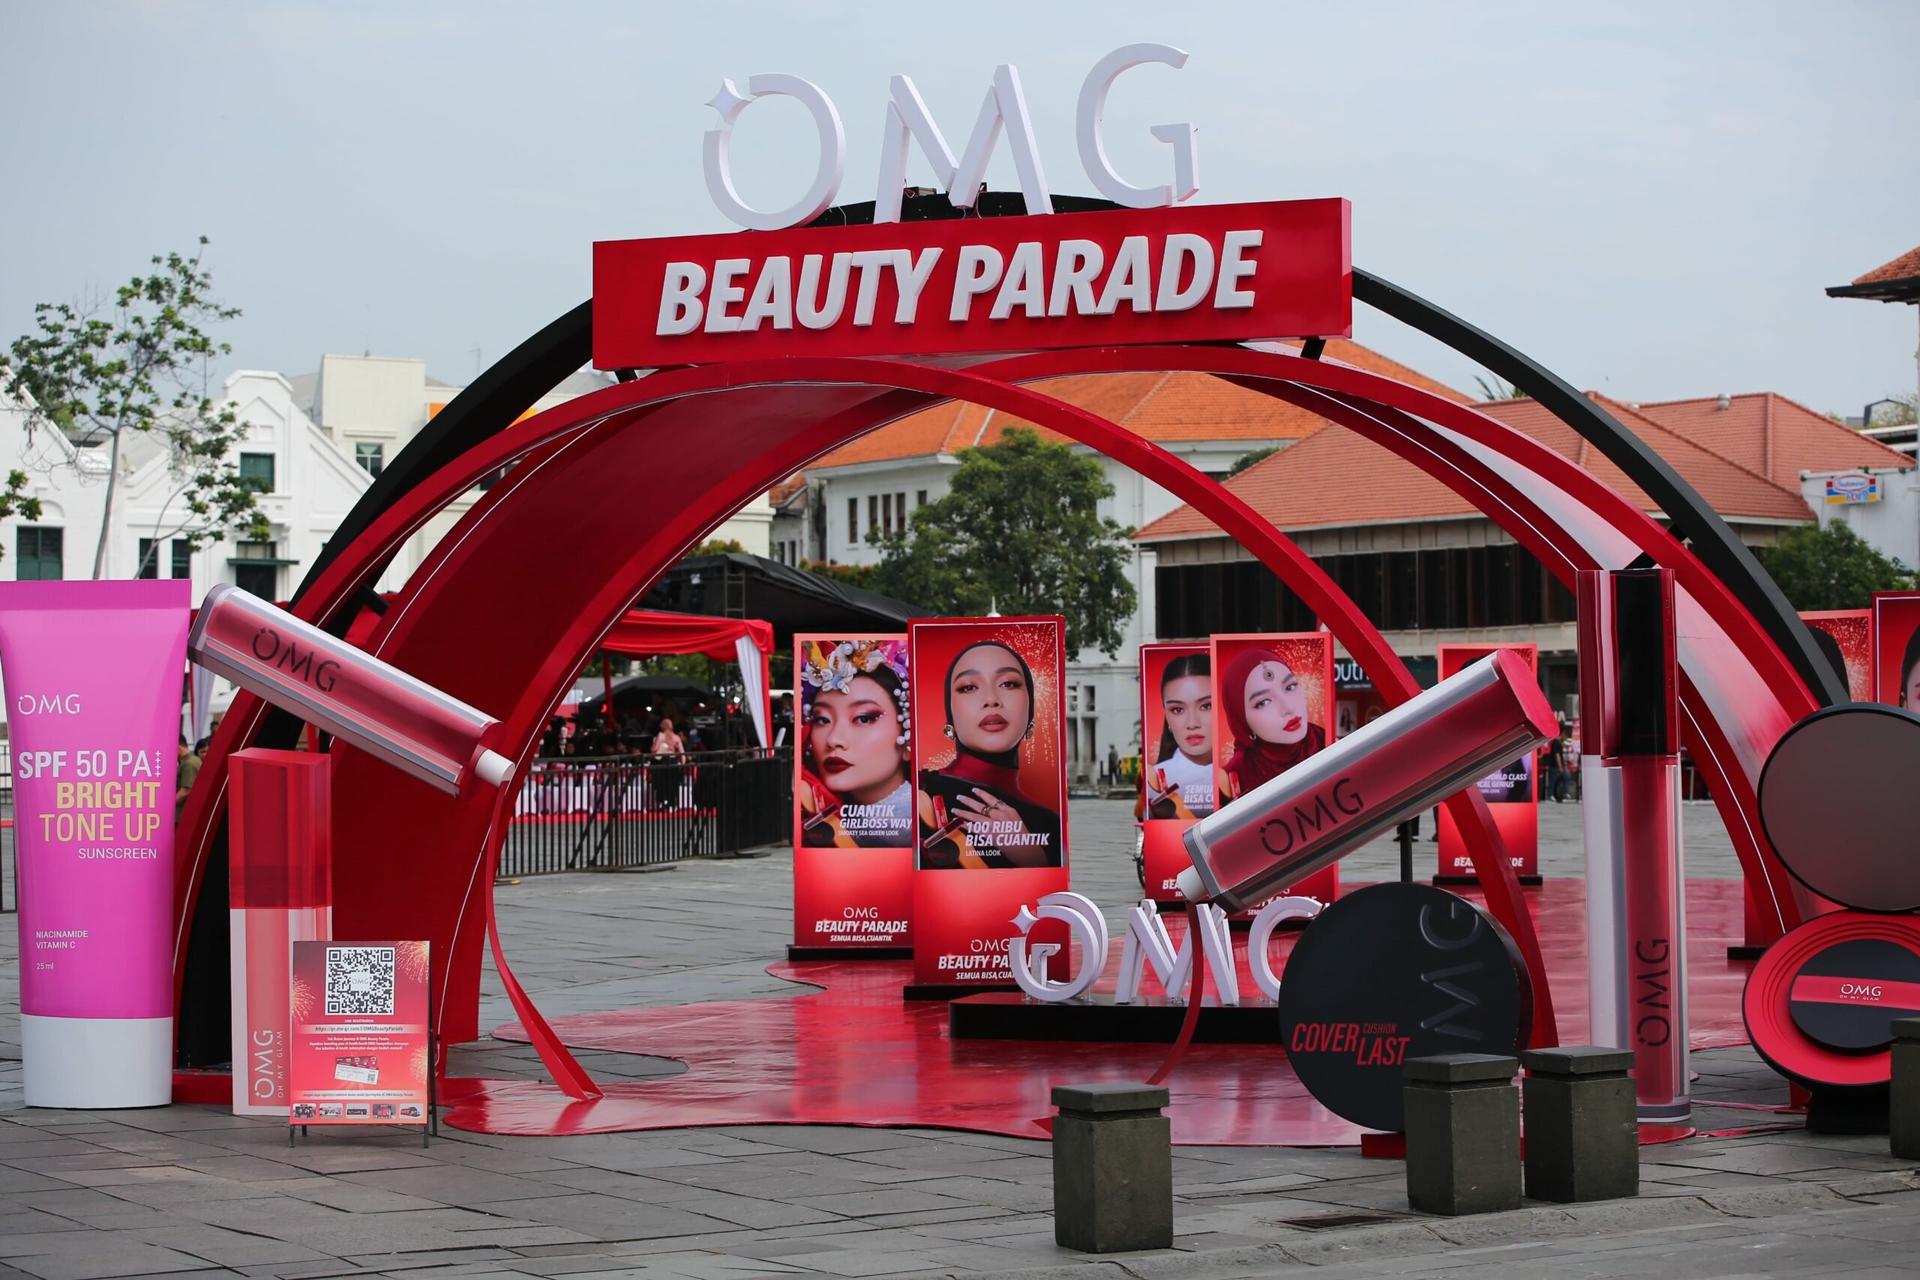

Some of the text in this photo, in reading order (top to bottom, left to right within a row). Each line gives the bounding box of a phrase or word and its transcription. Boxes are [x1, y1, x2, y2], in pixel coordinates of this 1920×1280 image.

[702, 43, 1199, 231] OMG
[656, 229, 1264, 336] BEAUTY PARADE
[252, 626, 341, 692] OMG
[18, 694, 81, 716] OMG
[18, 751, 67, 779] SPF
[76, 750, 107, 777] 50
[1508, 773, 1528, 781] CLASS
[56, 781, 161, 809] BRIGHT
[1183, 794, 1204, 803] BISA
[840, 804, 895, 817] CUANTIK
[1259, 778, 1364, 856] OMG
[39, 813, 161, 842] TONE UP
[840, 818, 912, 830] GIRLBOSS WAY
[966, 820, 1022, 833] 100 RIBU
[965, 833, 1050, 847] BISA CUANTIK
[78, 847, 157, 860] SUNSCREEN
[843, 907, 878, 919] OMG
[815, 920, 908, 933] BEAUTY PARADE
[35, 930, 89, 939] NIACINAMIDE
[36, 941, 76, 949] VITAMIN C
[36, 962, 45, 970] 25
[938, 955, 990, 969] BEAUTY
[956, 972, 980, 980] SEMUA
[1635, 939, 1670, 1047] OMG
[1841, 983, 1882, 997] OMG
[1291, 1023, 1398, 1052] COVER CUSHION
[1356, 1036, 1410, 1065] LAST
[253, 1030, 275, 1098] OMG
[276, 1031, 285, 1098] OH MY GLAM
